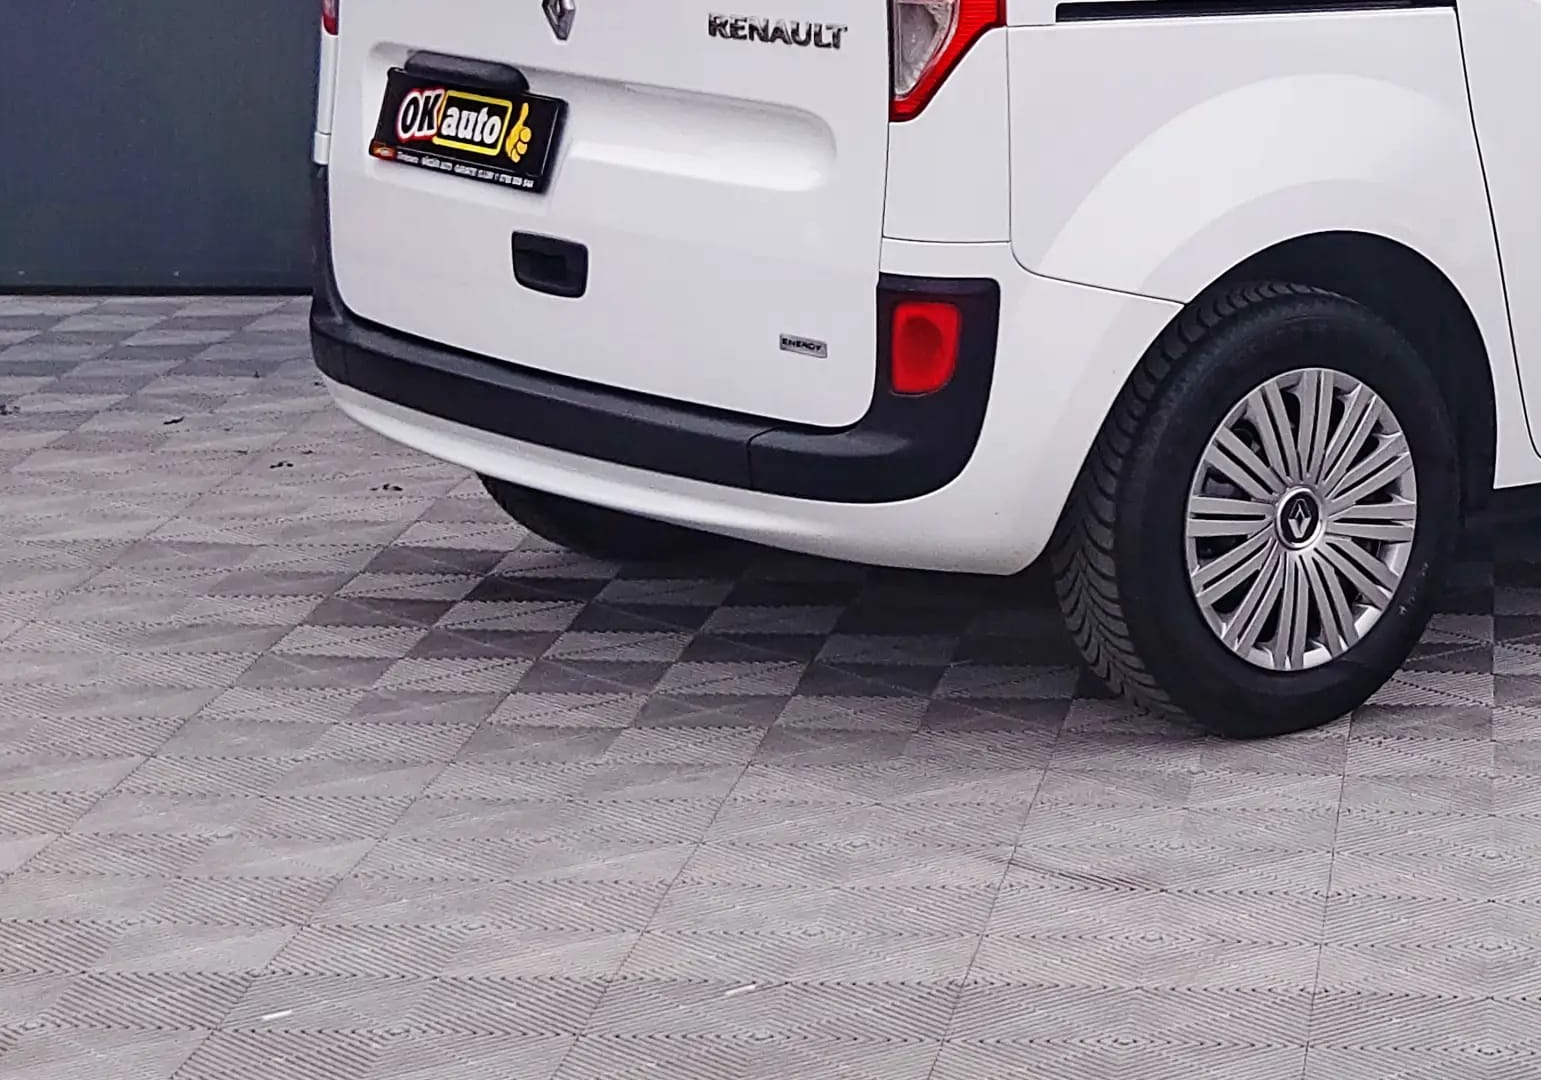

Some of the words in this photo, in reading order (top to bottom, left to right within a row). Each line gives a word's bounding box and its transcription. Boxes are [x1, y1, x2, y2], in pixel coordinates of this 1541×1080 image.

[708, 13, 848, 50] RENAULT
[398, 90, 443, 139] OK
[441, 106, 502, 145] auto
